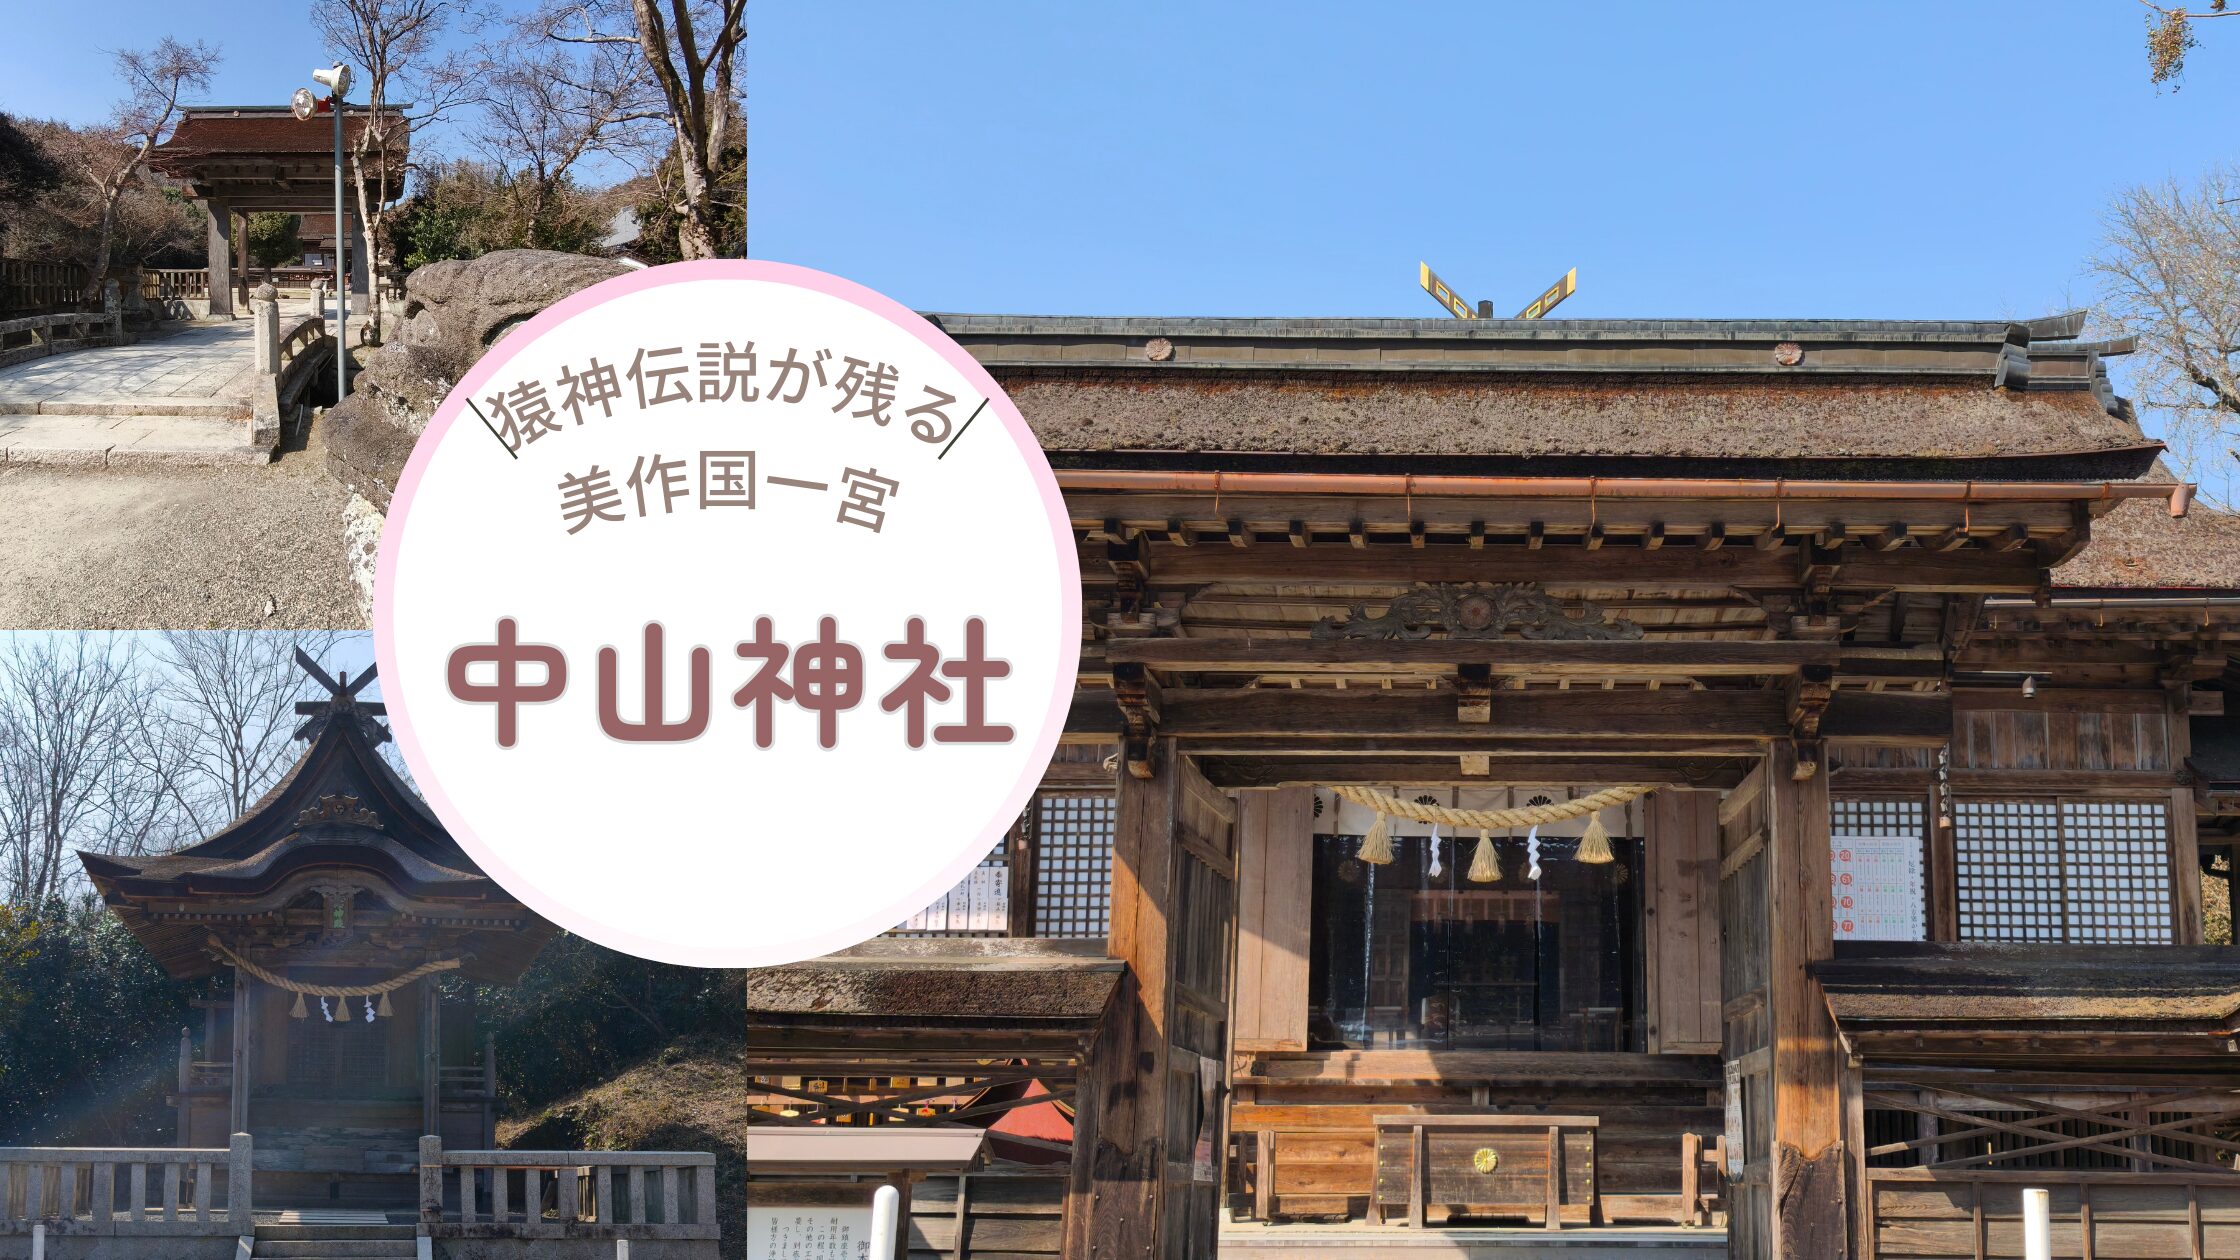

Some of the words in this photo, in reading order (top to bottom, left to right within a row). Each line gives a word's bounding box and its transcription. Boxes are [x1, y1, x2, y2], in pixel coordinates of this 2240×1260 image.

[768, 1217, 778, 1260] 皆様方の浄
[805, 1217, 814, 1260] その他の工
[829, 1217, 838, 1260] 耐用年数も
